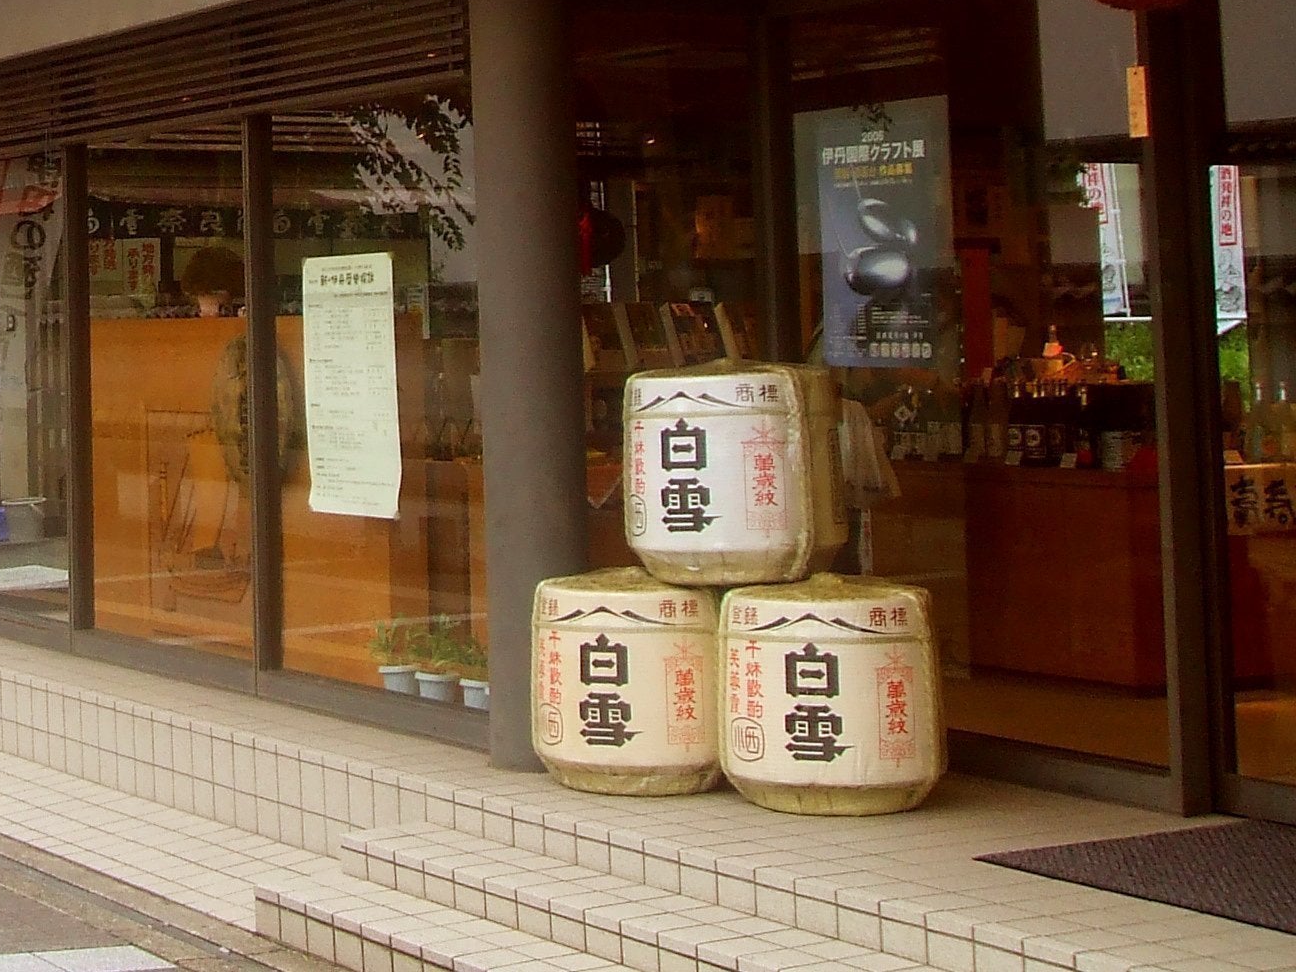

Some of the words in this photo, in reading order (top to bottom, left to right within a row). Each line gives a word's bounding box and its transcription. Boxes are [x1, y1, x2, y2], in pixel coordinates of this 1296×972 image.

[735, 383, 780, 403] 商標
[660, 417, 723, 533] 白雪
[659, 599, 699, 618] 商標
[869, 607, 909, 627] 商標
[579, 633, 645, 747] 白雪
[785, 642, 855, 762] 白雪
